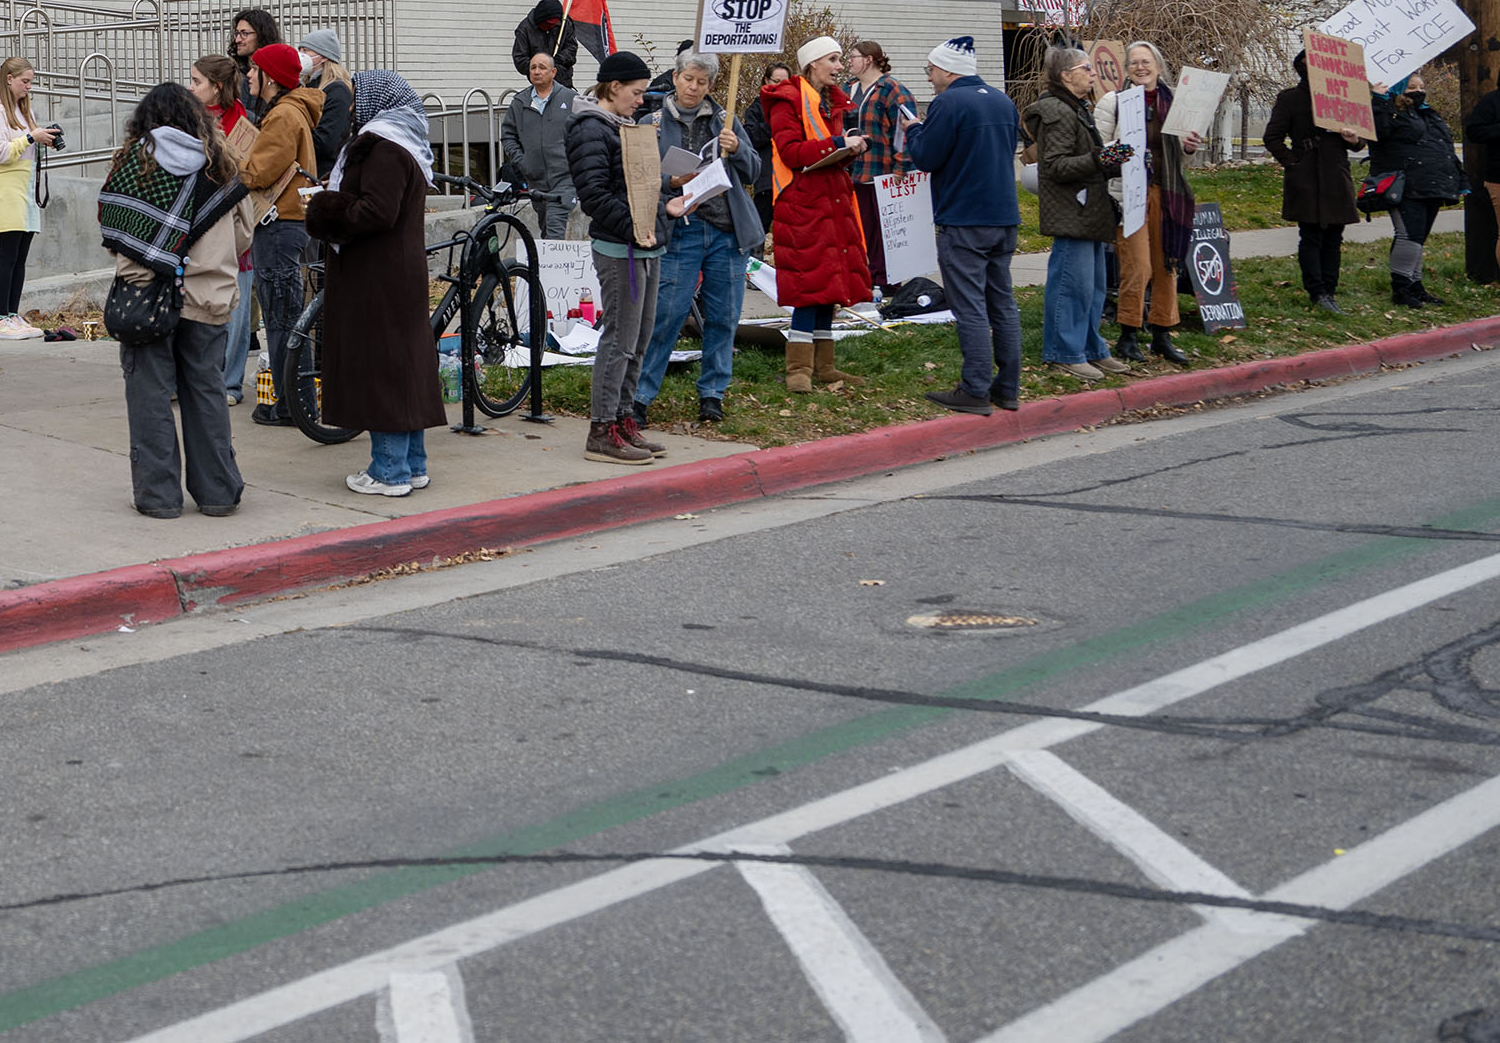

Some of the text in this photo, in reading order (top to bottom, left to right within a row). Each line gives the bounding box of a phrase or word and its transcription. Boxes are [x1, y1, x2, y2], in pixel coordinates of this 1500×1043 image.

[735, 23, 752, 33] THE
[1325, 11, 1363, 38] Good
[1407, 12, 1455, 50] ICE
[705, 33, 778, 46] DEPORTATIONS!
[1097, 60, 1119, 81] ICE
[1325, 78, 1349, 99] NOT
[881, 172, 928, 190] NAUGHTY
[890, 184, 917, 198] LIST
[887, 201, 904, 215] ICE
[889, 214, 914, 228] Epstein
[891, 227, 907, 237] Trump
[1194, 227, 1225, 241] ILLEGAL
[542, 242, 591, 259] Shame!
[539, 260, 585, 279] Enforcemen
[547, 286, 570, 299] NO
[442, 293, 460, 326] AVEN
